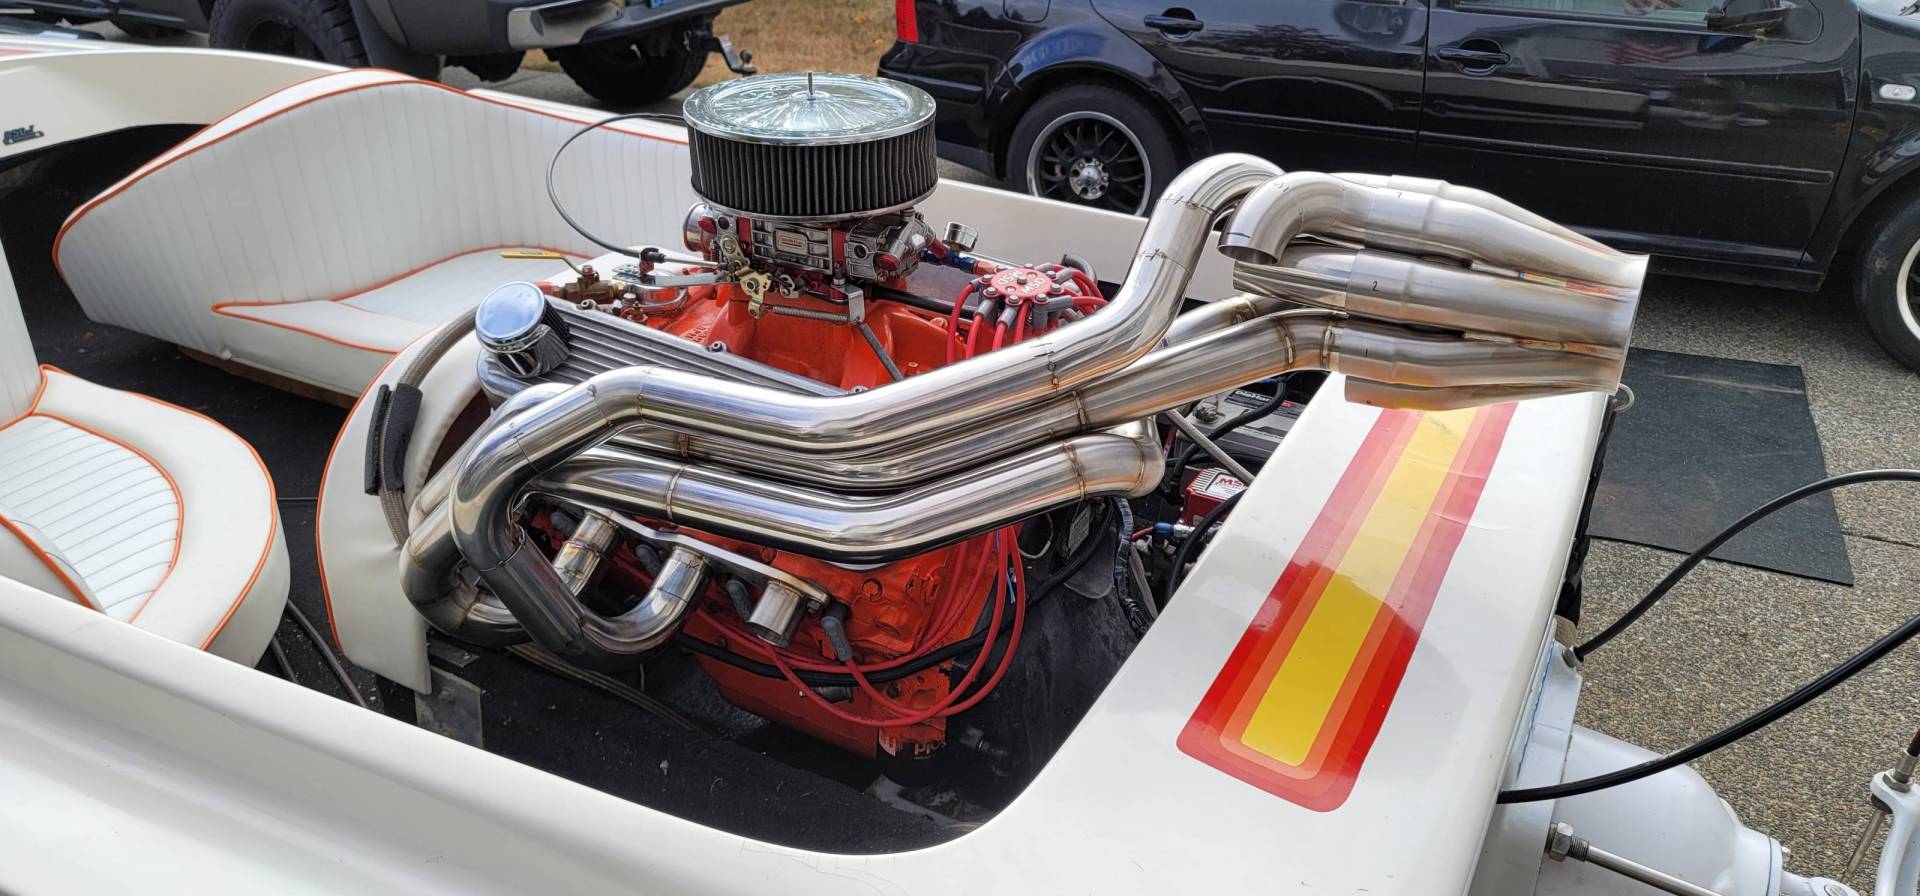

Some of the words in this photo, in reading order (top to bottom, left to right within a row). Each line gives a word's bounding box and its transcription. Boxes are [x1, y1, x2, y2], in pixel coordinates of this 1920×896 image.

[1020, 278, 1045, 294] MSD
[1372, 280, 1379, 292] 2
[1219, 478, 1247, 489] MS
